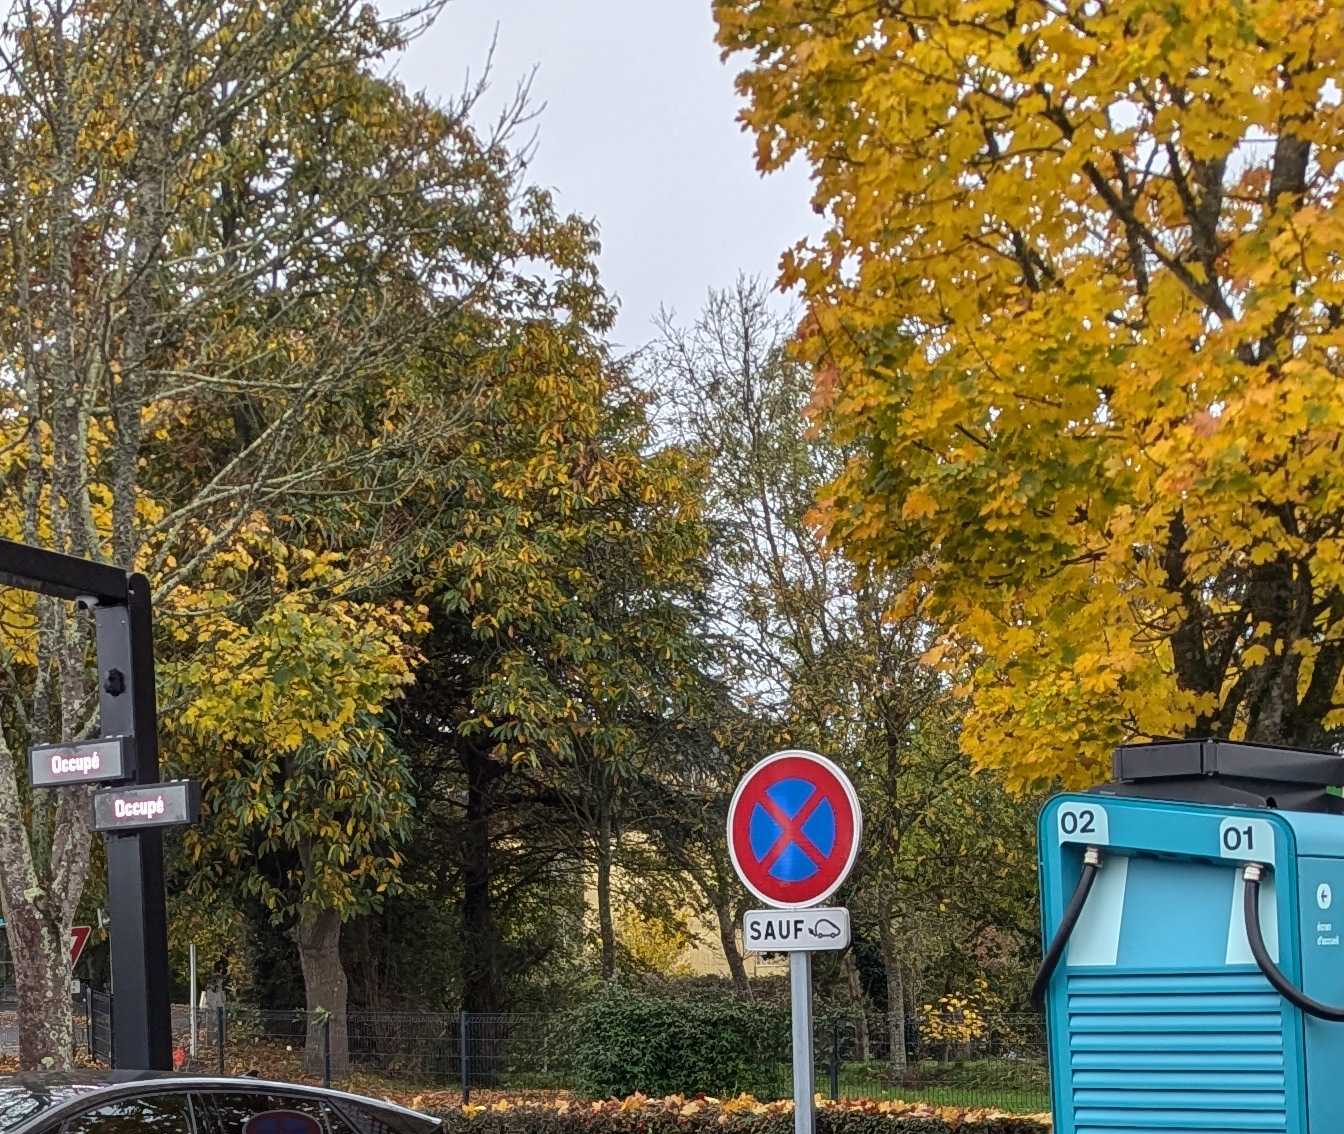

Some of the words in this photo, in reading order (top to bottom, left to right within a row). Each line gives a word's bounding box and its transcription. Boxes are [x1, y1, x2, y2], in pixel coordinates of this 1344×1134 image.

[50, 751, 100, 775] Occupé
[114, 795, 164, 819] Occupé
[1060, 810, 1096, 835] 02
[1223, 826, 1255, 851] 01
[749, 919, 805, 941] SAUF
